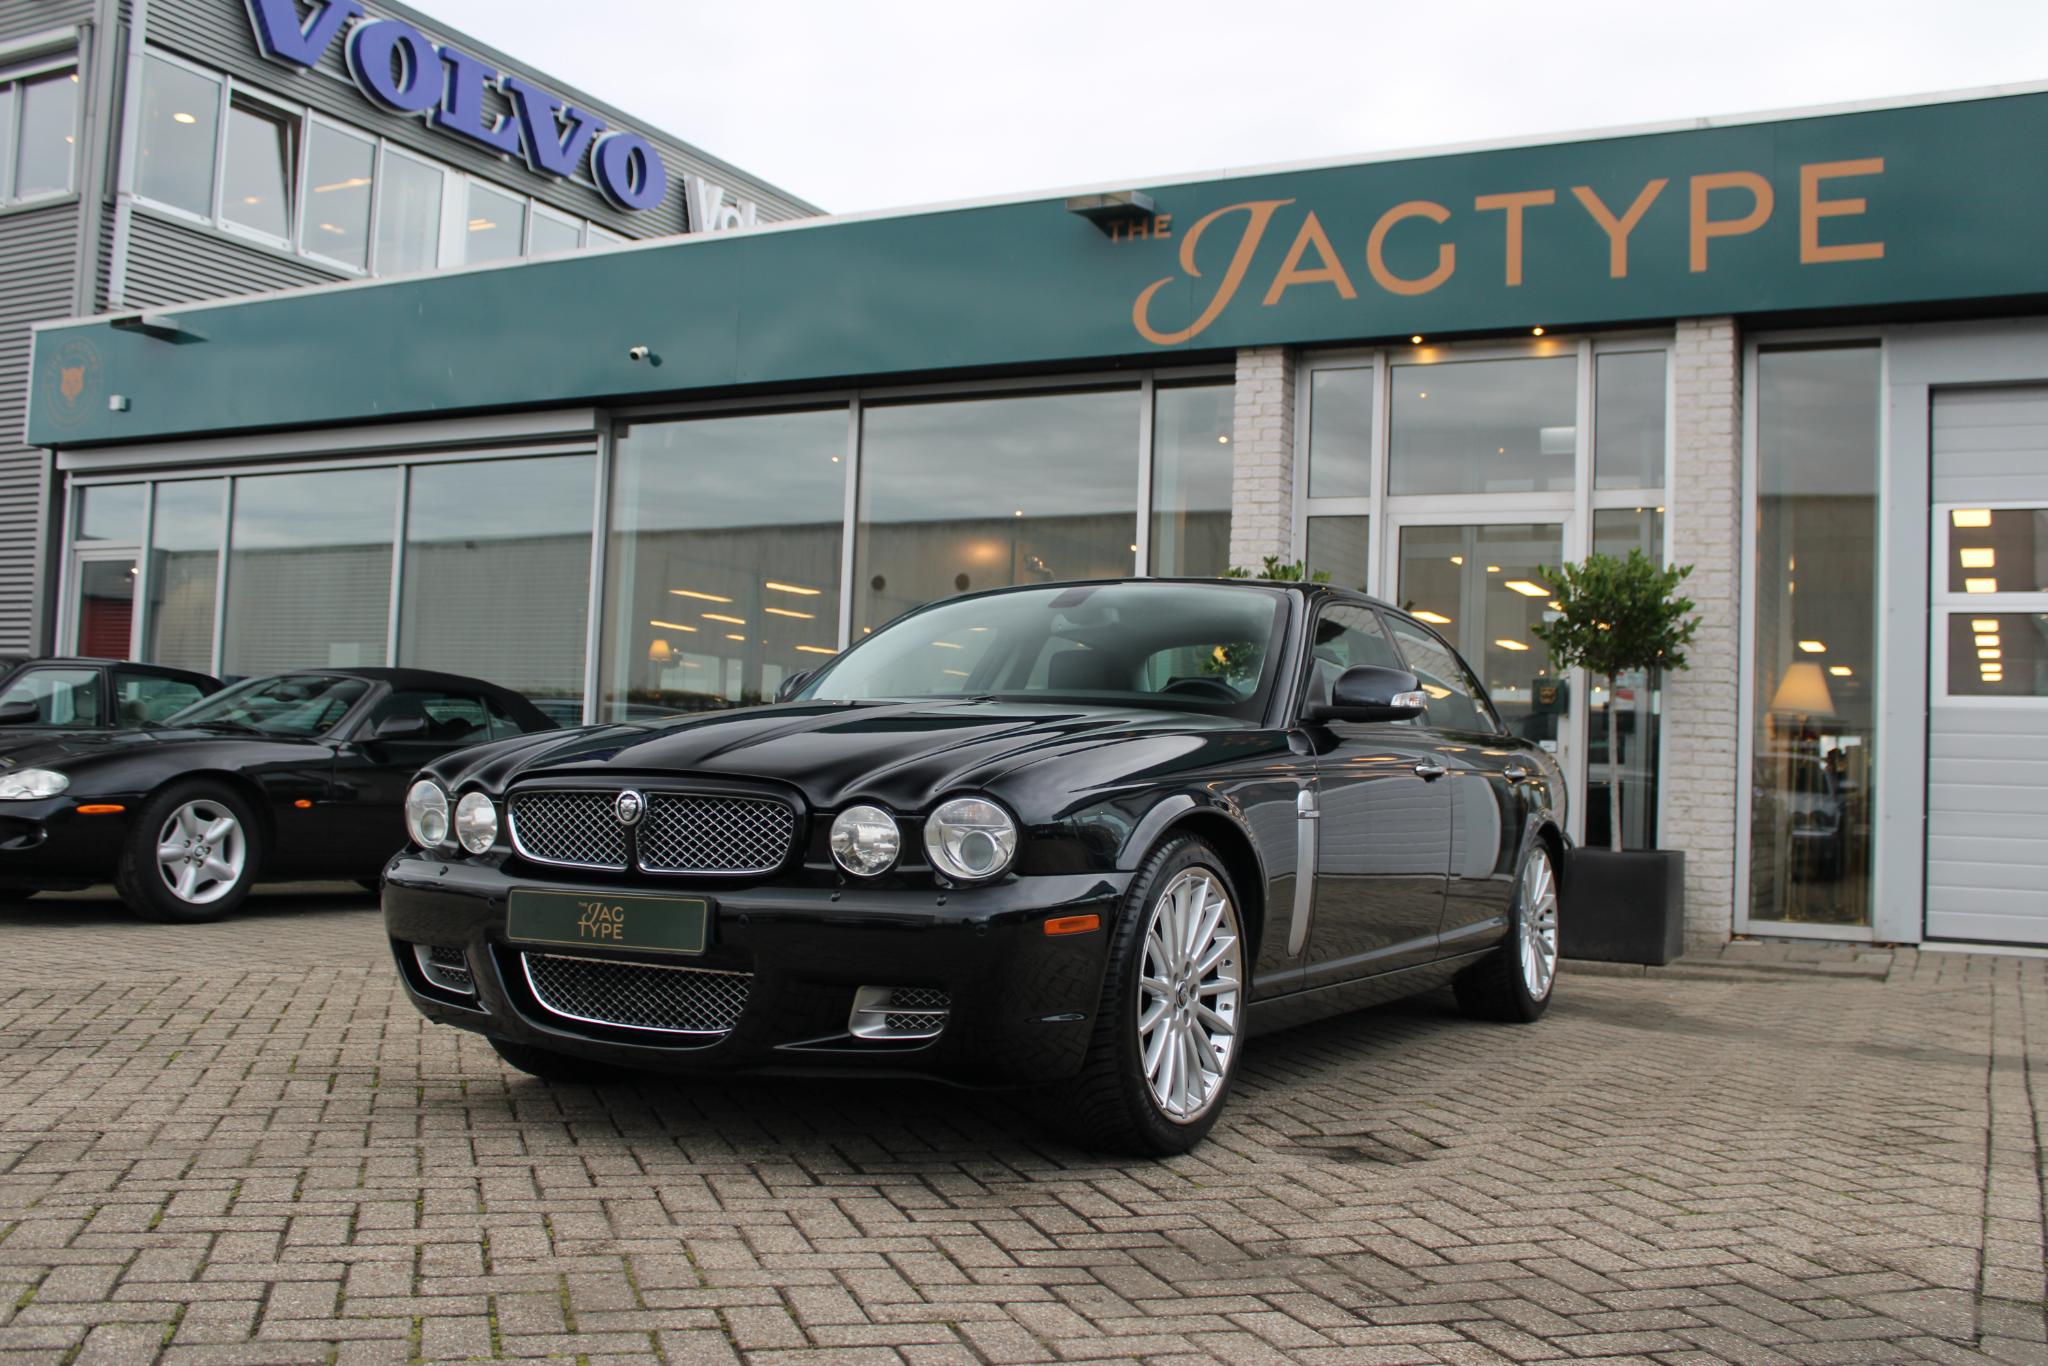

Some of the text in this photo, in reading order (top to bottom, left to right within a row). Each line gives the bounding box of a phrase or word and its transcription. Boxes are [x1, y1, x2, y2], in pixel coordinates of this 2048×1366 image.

[243, 0, 667, 213] VOLVO
[683, 173, 766, 234] Vol
[1108, 157, 1885, 345] THE JAGTYPE
[576, 921, 625, 940] TYPE
[582, 902, 625, 924] JAG
